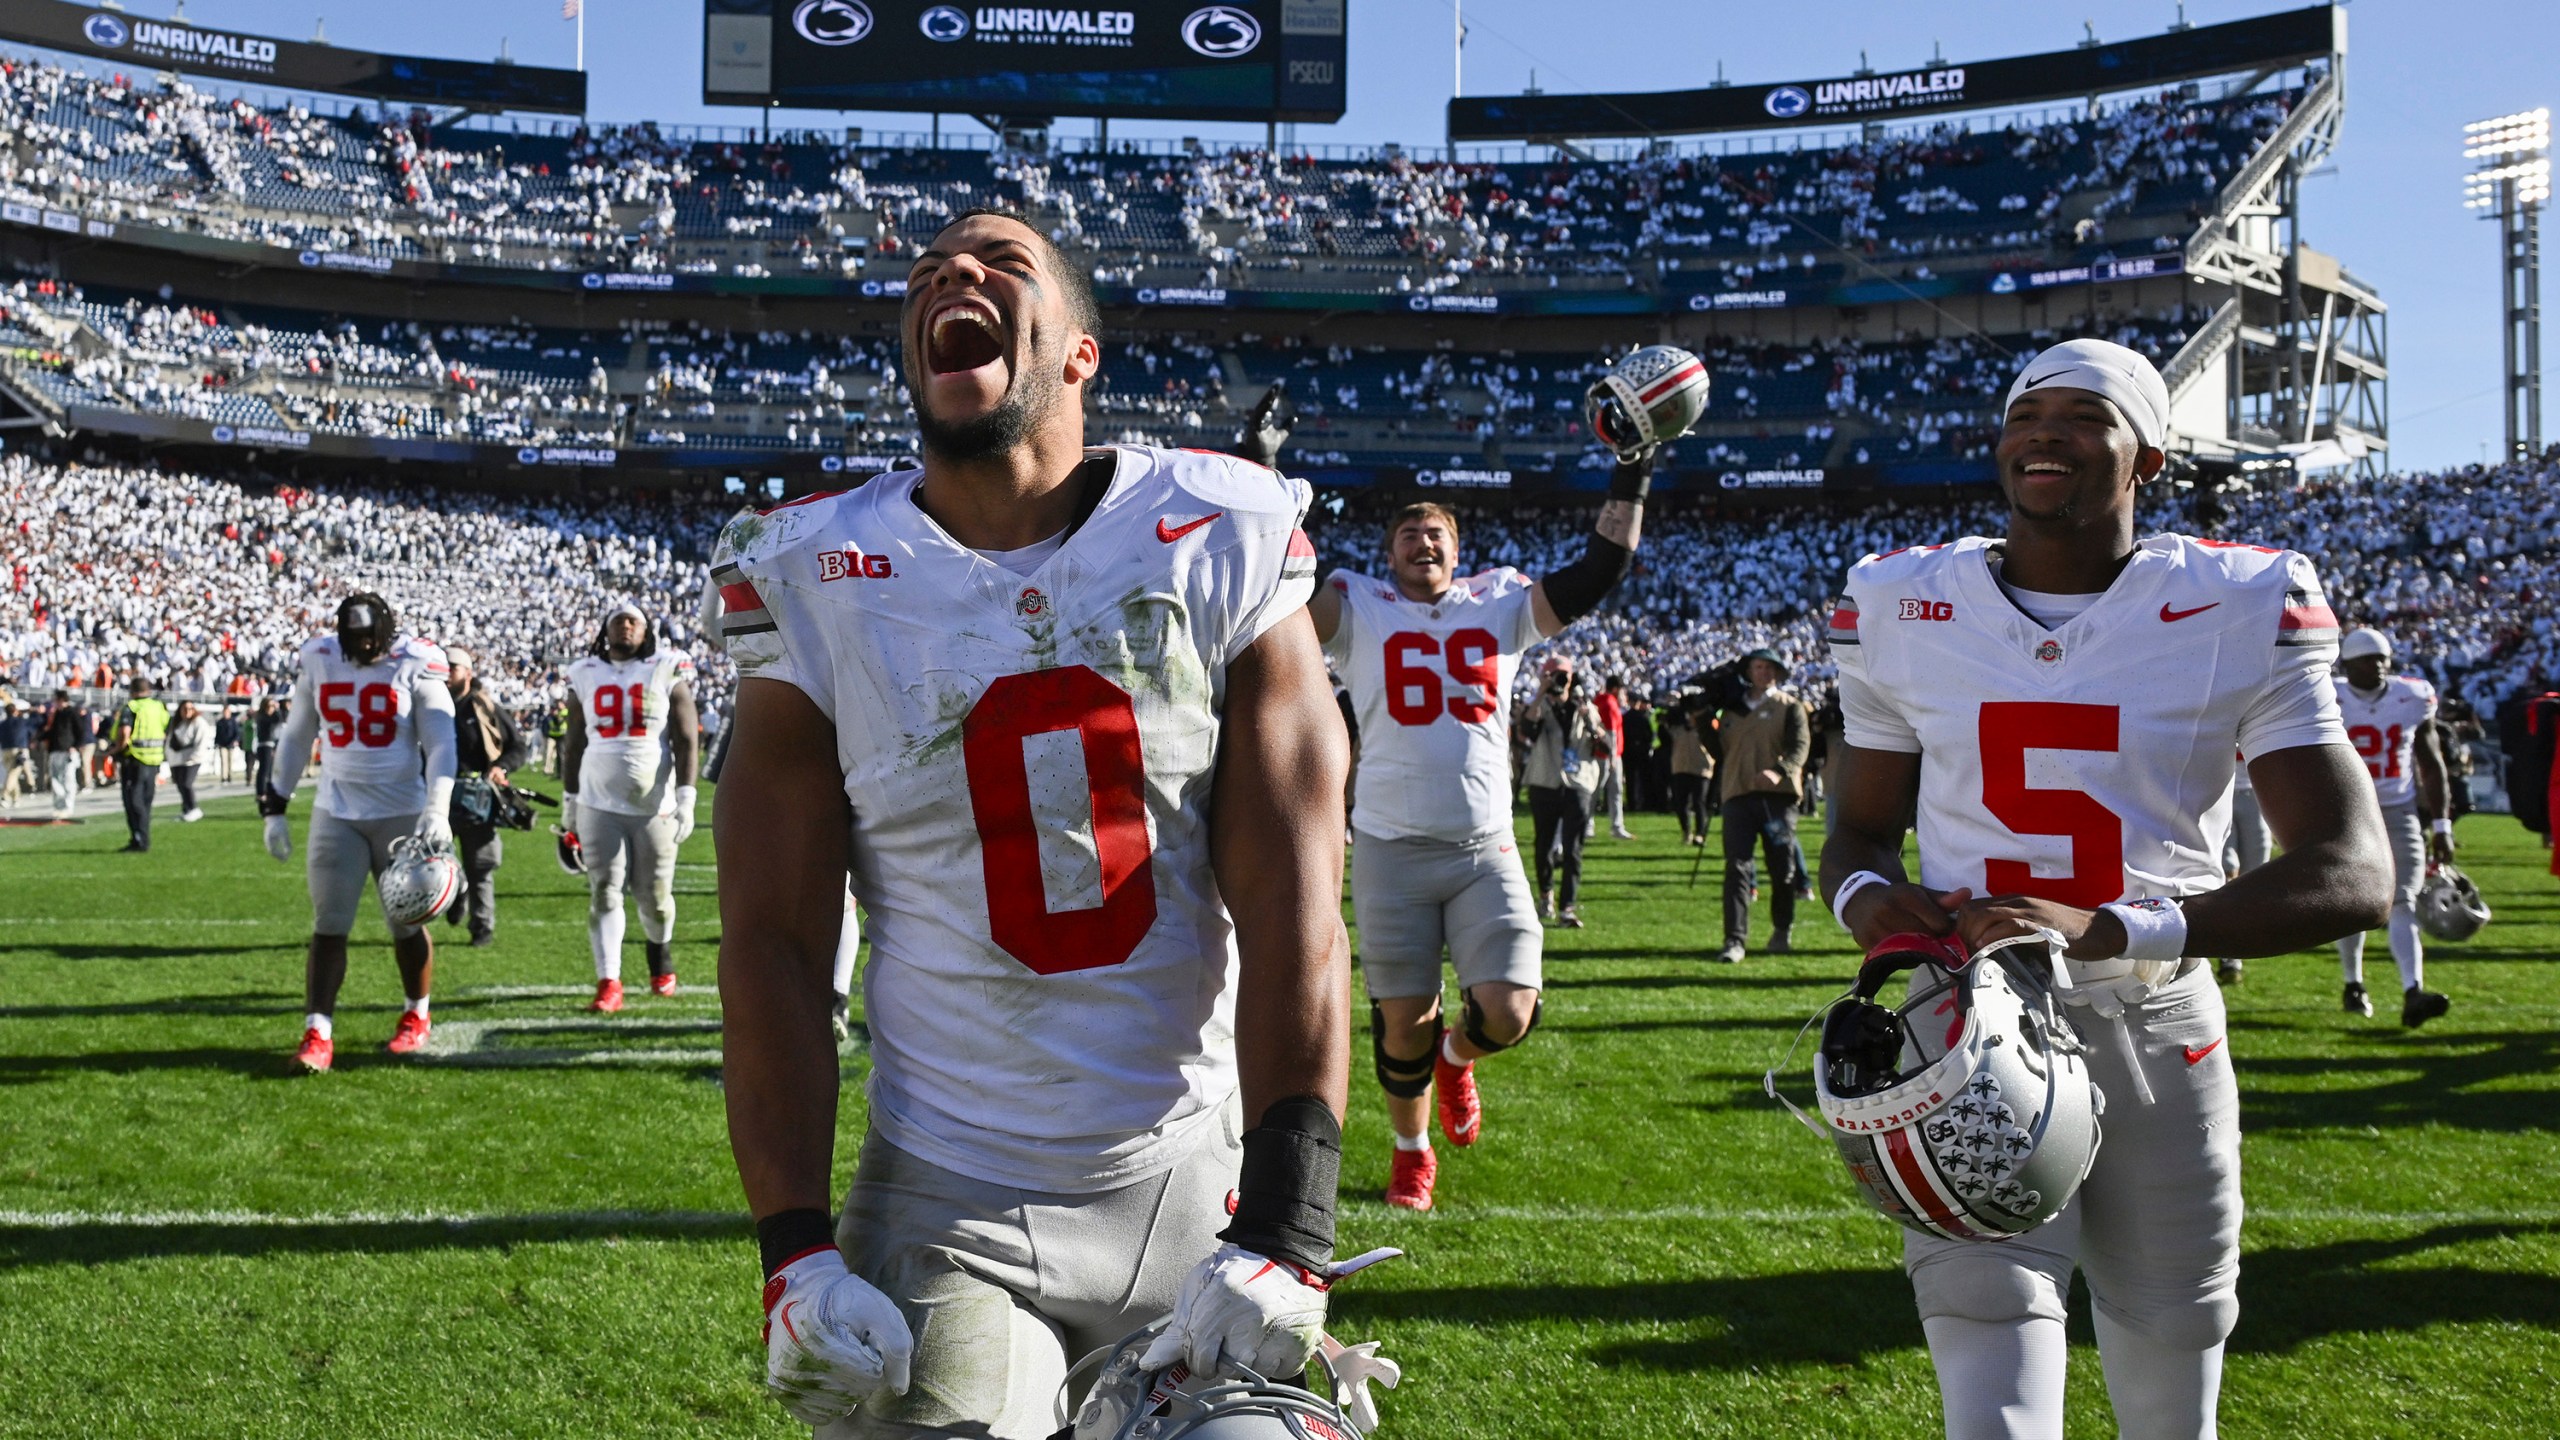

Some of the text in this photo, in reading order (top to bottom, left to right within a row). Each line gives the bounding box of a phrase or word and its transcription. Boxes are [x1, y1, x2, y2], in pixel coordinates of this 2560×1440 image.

[975, 7, 1134, 35] UNRIVALED
[133, 21, 277, 63] UNRIVALED
[975, 33, 1134, 47] PENN STATE FOOTBALL
[170, 50, 207, 65] STATE
[213, 56, 276, 74] FOOTBALL
[1289, 61, 1334, 84] PSECU
[1815, 68, 1965, 105] UNRIVALED
[1855, 99, 1893, 112] STATE
[605, 273, 674, 286] UNRIVALED
[1160, 288, 1226, 301] UNRIVALED
[1431, 295, 1498, 308] UNRIVALED
[1713, 290, 1786, 305] UNRIVALED
[542, 448, 617, 462] UNRIVALED
[1440, 469, 1512, 483] UNRIVALED
[1745, 469, 1824, 483] UNRIVALED
[1384, 628, 1498, 726] 69
[319, 682, 398, 748] 58
[594, 682, 647, 738] 91
[2347, 724, 2403, 778] 21
[1978, 701, 2124, 909] 5
[962, 664, 1158, 976] 0
[1836, 1092, 1943, 1131] BUCKEYES
